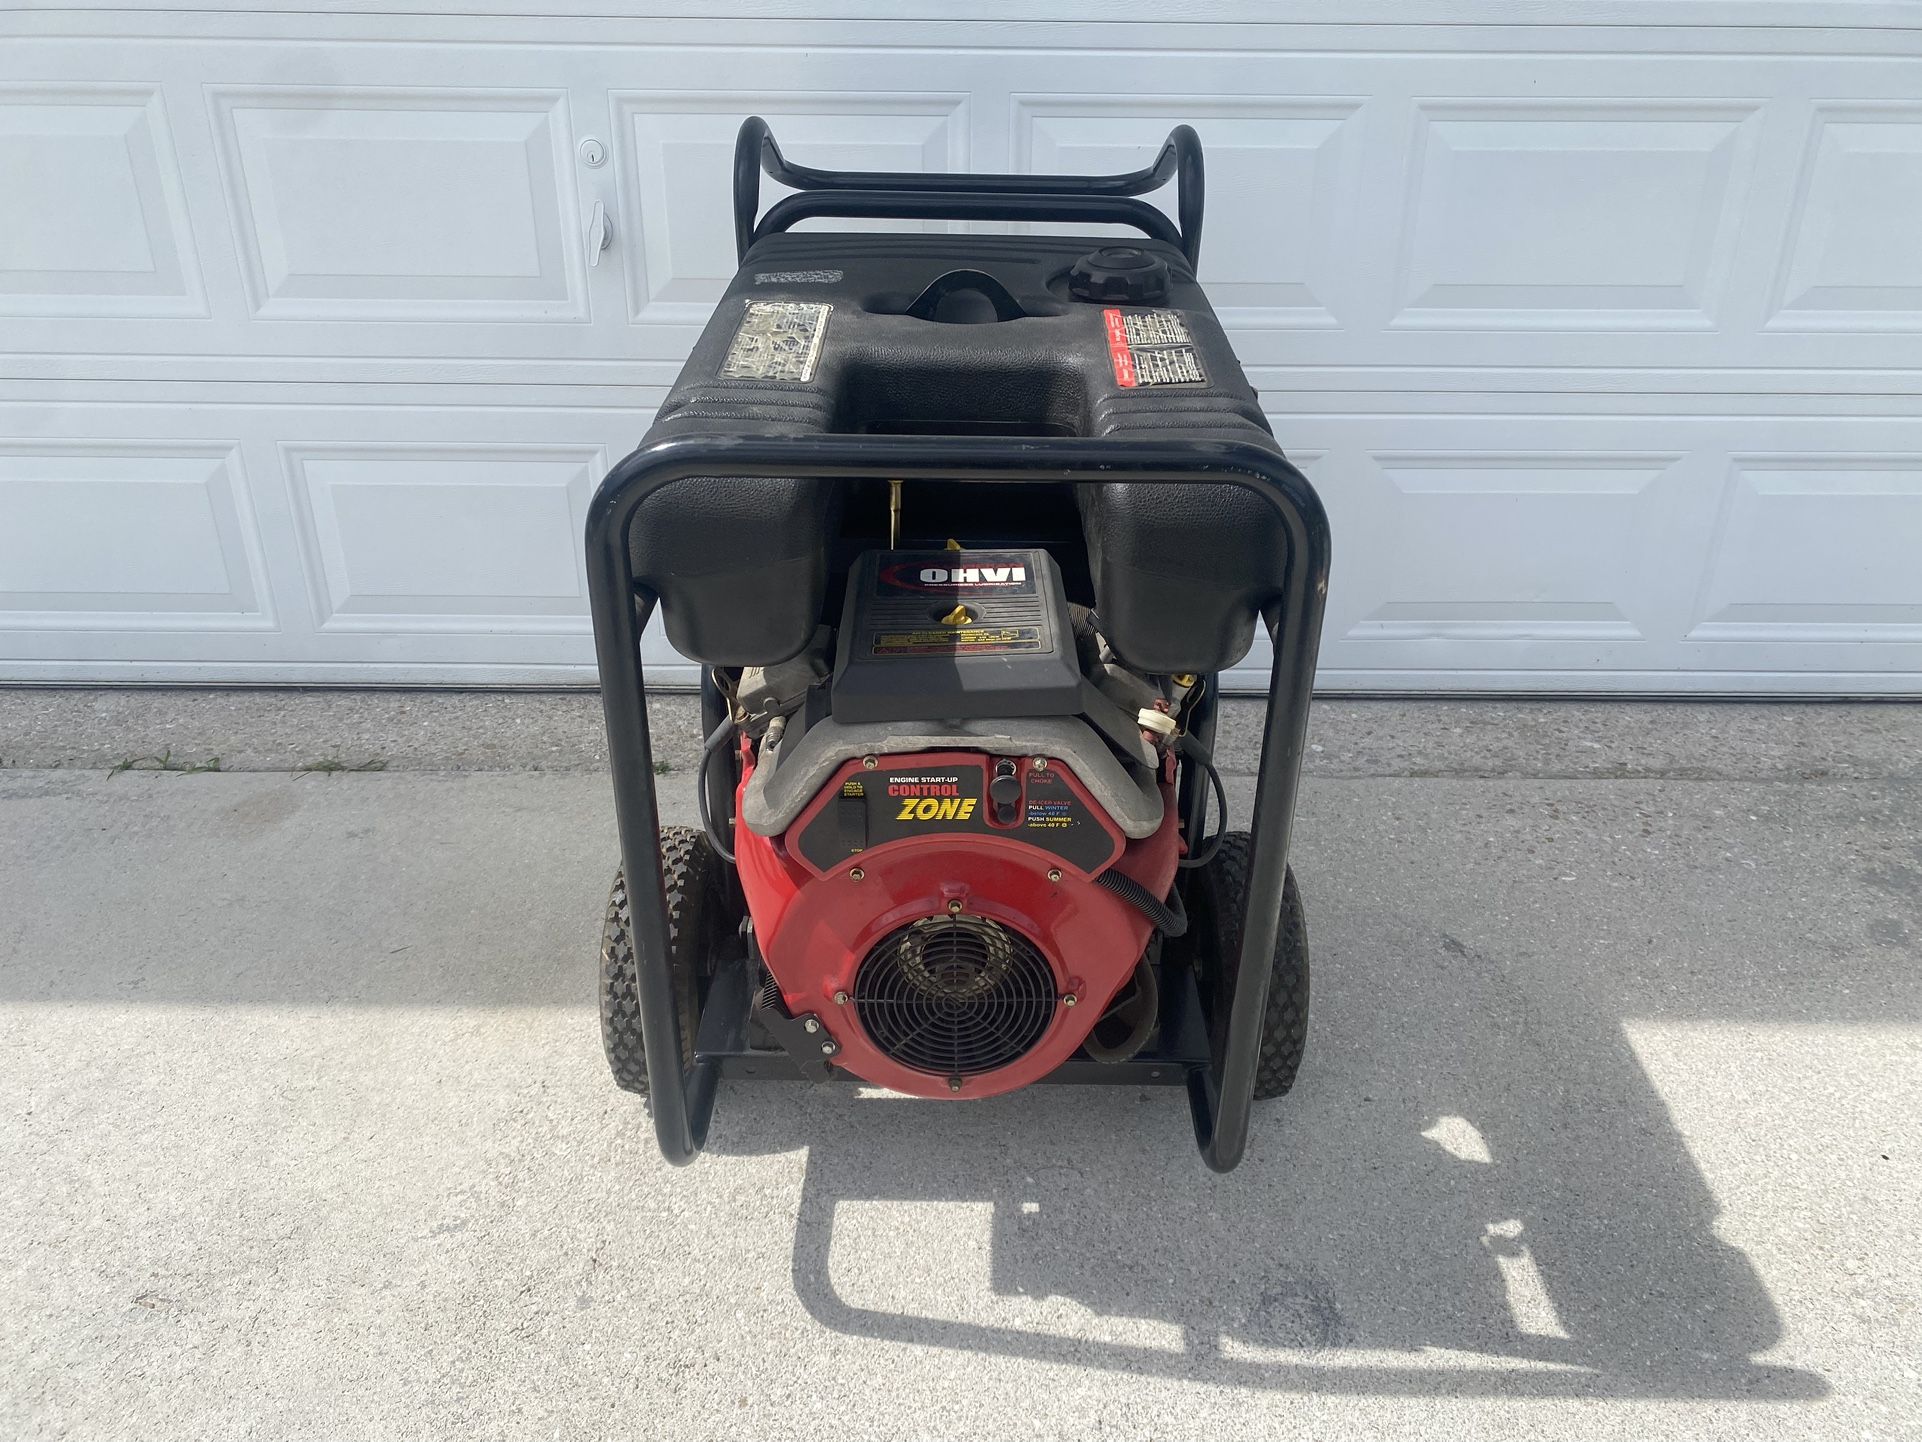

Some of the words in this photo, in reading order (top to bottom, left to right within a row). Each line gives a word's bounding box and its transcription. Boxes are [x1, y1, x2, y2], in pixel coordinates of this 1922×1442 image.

[920, 567, 1026, 583] OHVI
[888, 784, 959, 797] CONTROL
[895, 798, 978, 821] ZONE
